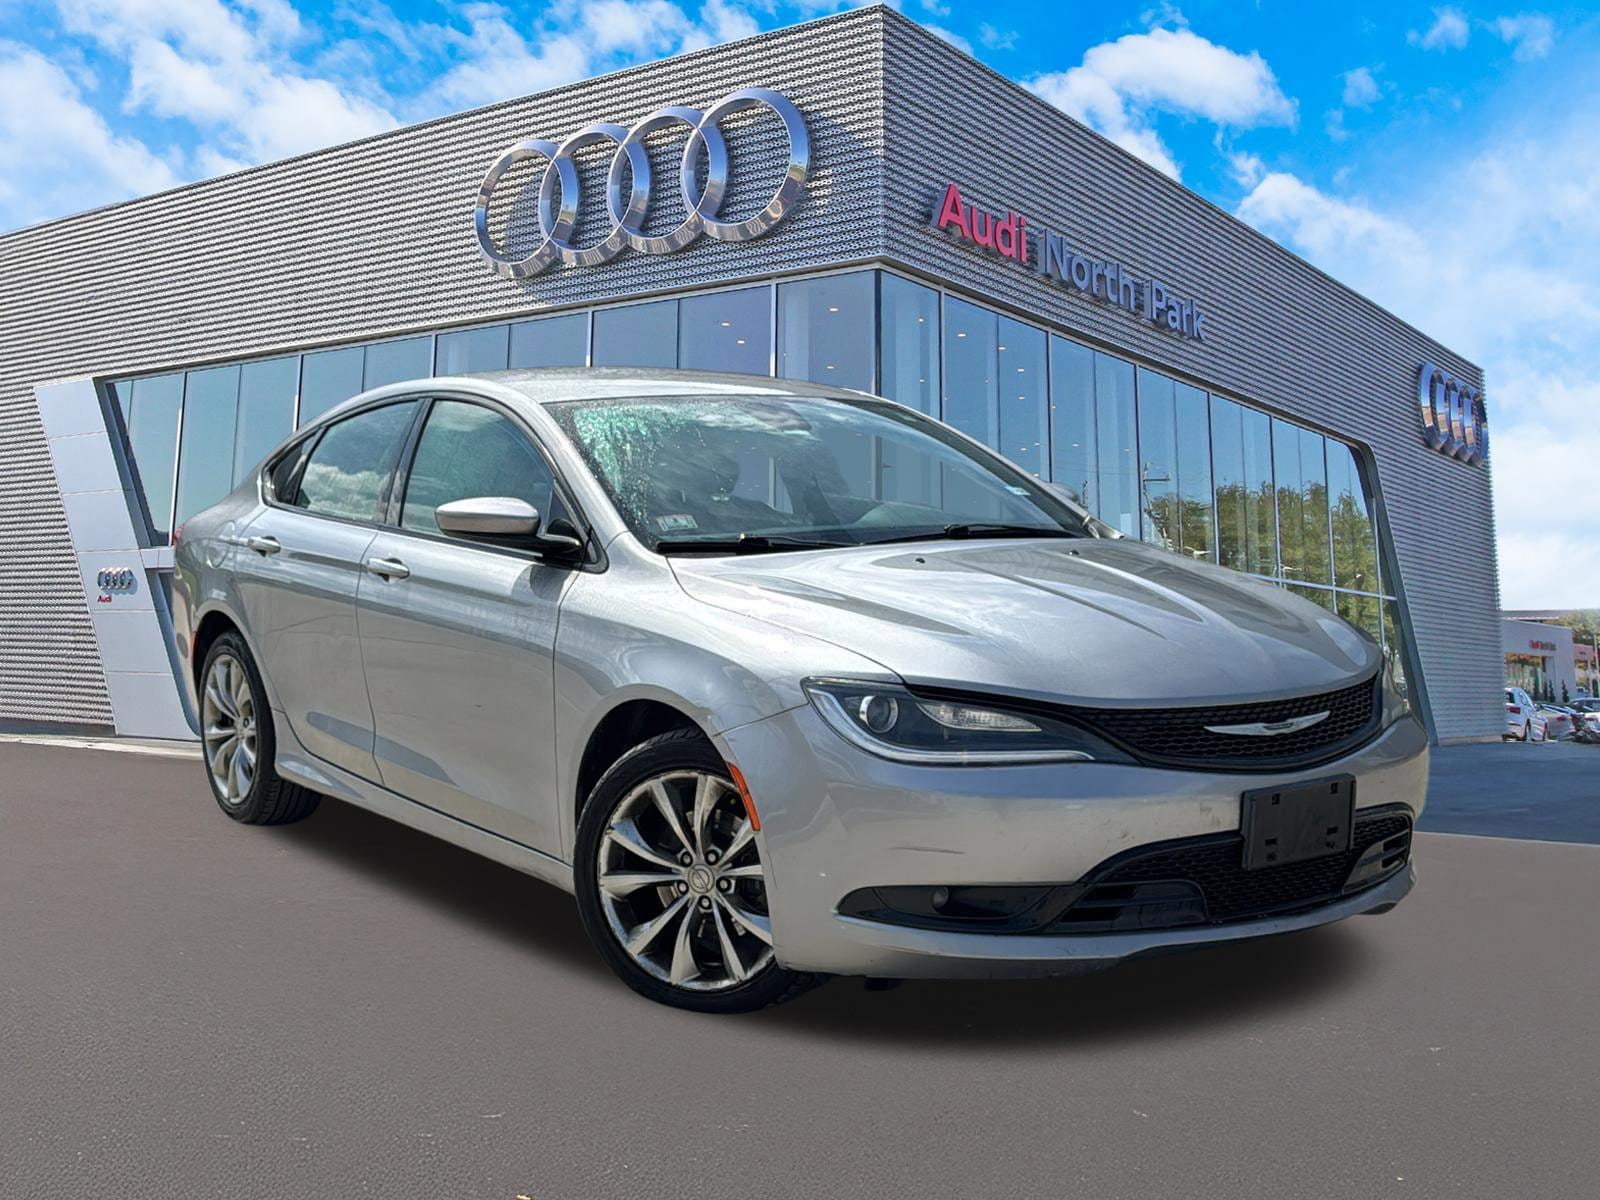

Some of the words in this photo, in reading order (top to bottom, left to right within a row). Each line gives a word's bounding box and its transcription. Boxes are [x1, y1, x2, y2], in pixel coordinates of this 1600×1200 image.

[932, 183, 1028, 263] Audi
[1038, 229, 1136, 309] North
[1144, 279, 1206, 340] Park
